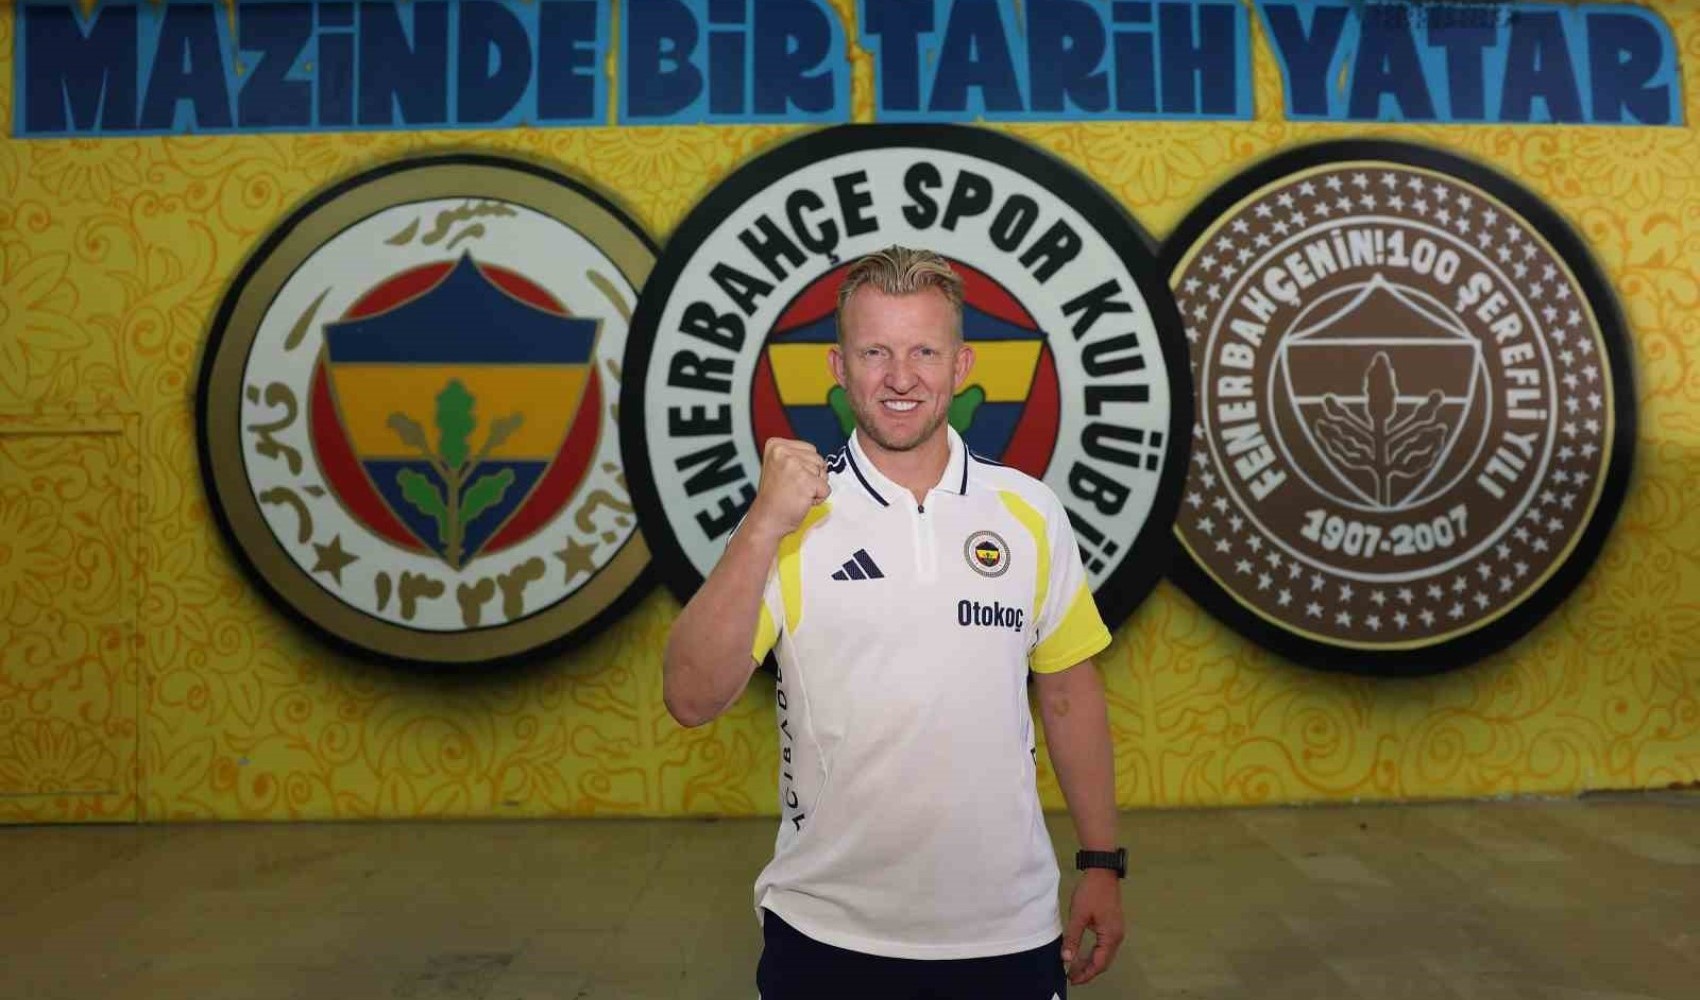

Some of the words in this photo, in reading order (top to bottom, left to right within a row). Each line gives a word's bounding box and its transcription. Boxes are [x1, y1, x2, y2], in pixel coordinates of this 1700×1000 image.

[626, 1, 836, 122] BİR
[864, 1, 1236, 114] TARİH
[1263, 3, 1670, 126] YATAR
[667, 170, 879, 541] ENERBAHÇE
[901, 161, 1083, 284] SPOR
[1454, 272, 1547, 420] ŞEREFLİ
[1301, 504, 1469, 557] 1907-2007
[957, 599, 1024, 632] Otokoç
